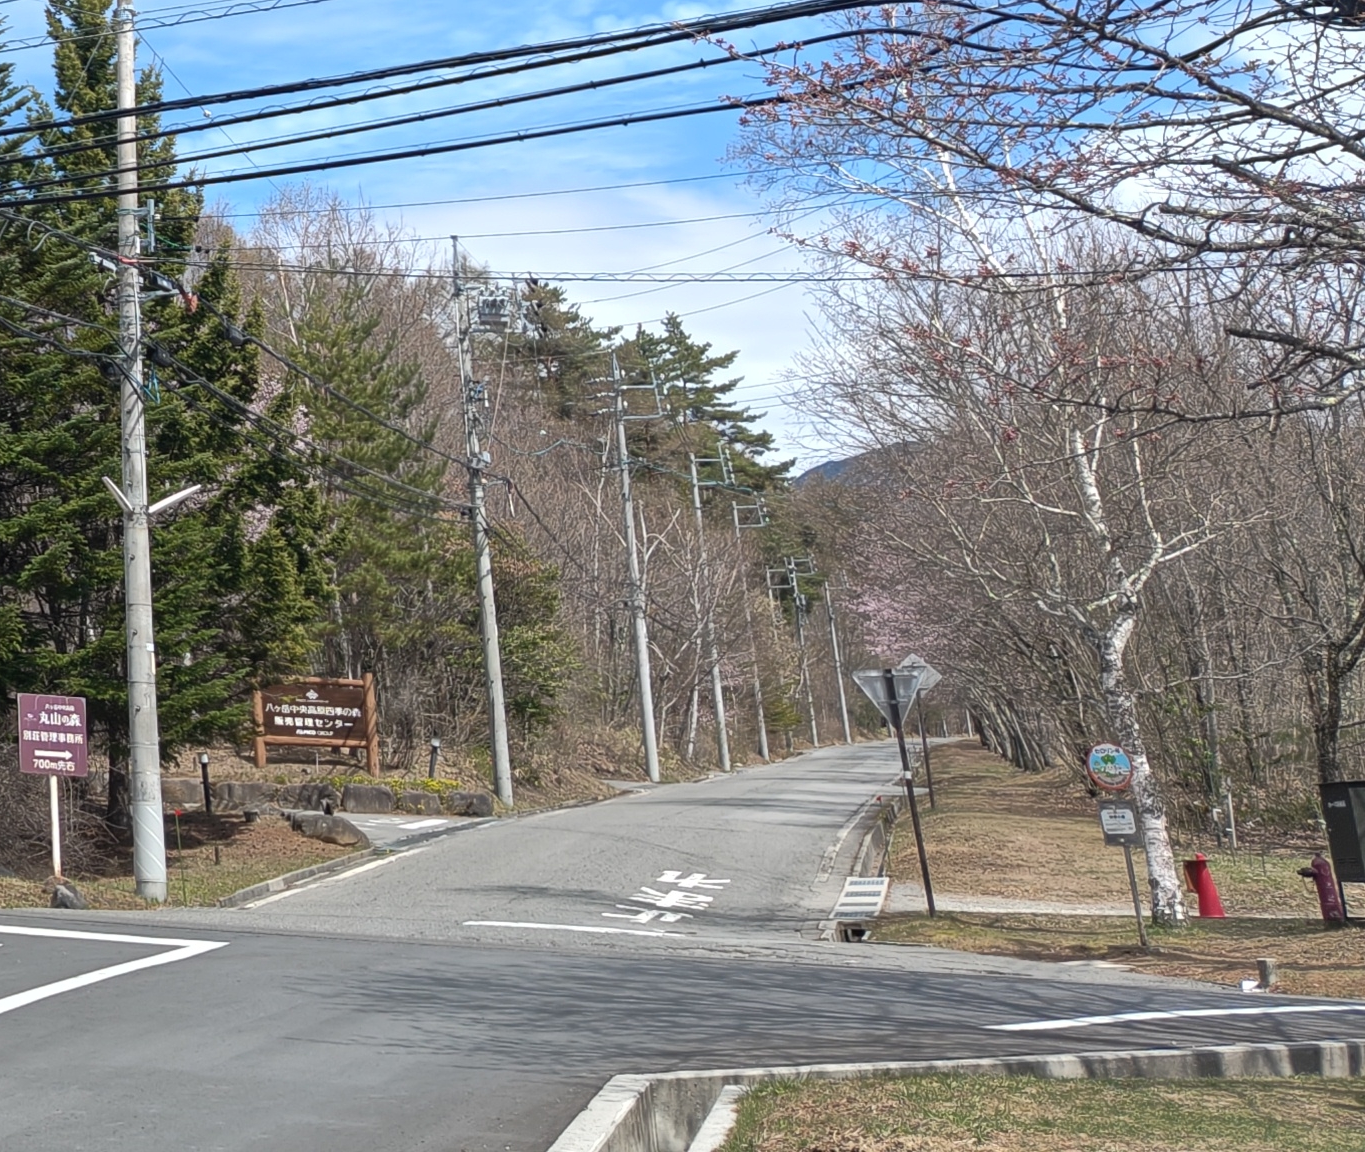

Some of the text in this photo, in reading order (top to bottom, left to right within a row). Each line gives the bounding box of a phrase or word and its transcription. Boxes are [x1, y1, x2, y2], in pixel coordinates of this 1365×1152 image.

[38, 711, 82, 727] 丸山の森
[274, 715, 354, 729] 販売管理センター
[32, 758, 76, 772] 700m先右
